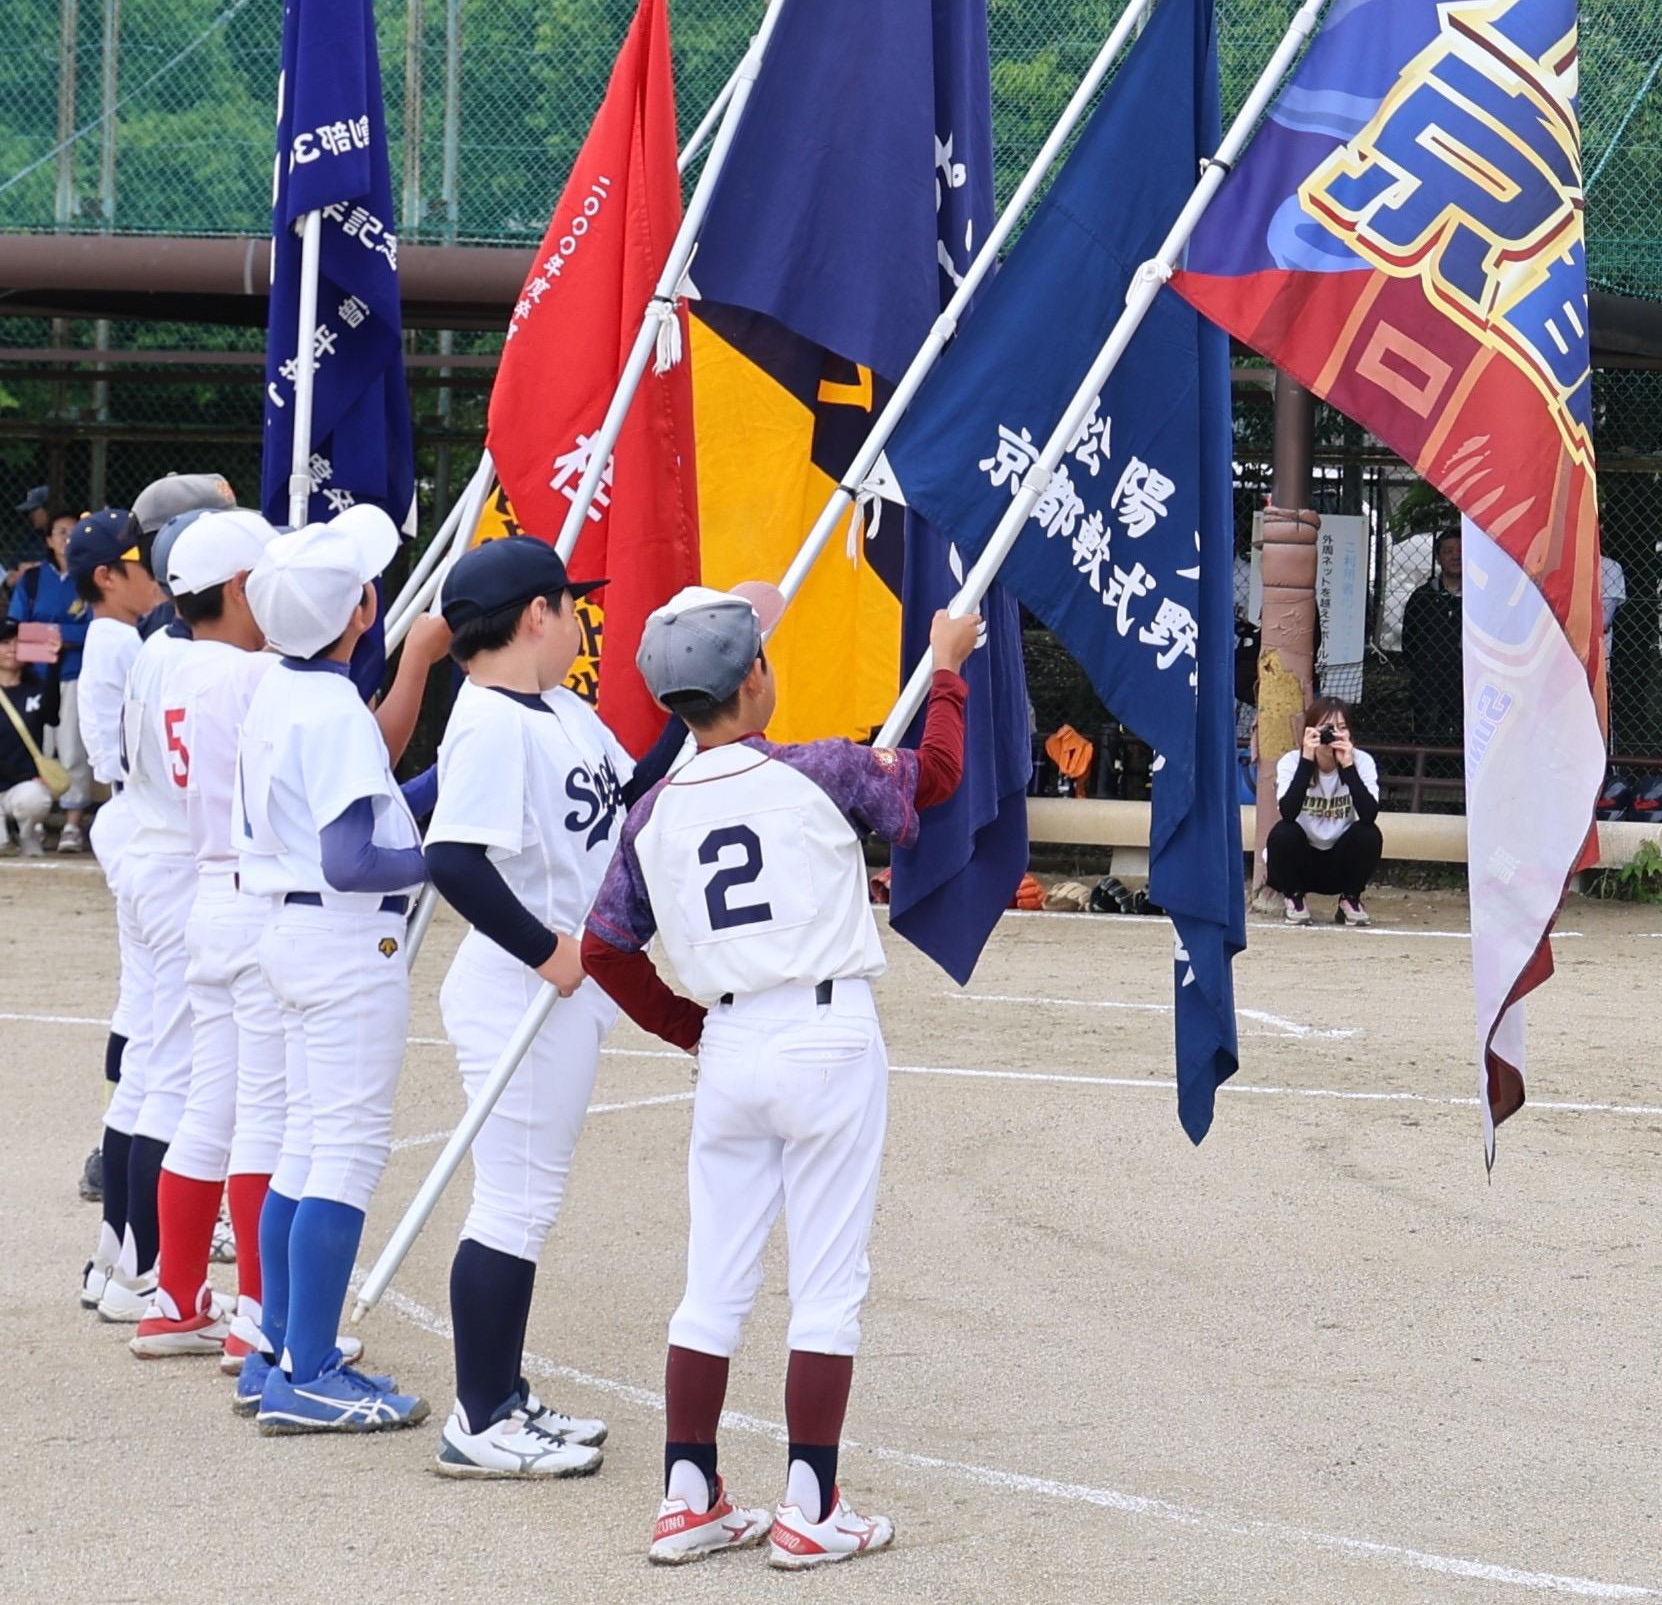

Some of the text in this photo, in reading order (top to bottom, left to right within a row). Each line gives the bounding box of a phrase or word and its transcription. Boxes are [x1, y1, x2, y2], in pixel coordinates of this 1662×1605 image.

[979, 423, 1199, 696] 京都軟式野
[25, 694, 43, 712] K
[164, 707, 190, 788] 5
[697, 823, 773, 932] 2
